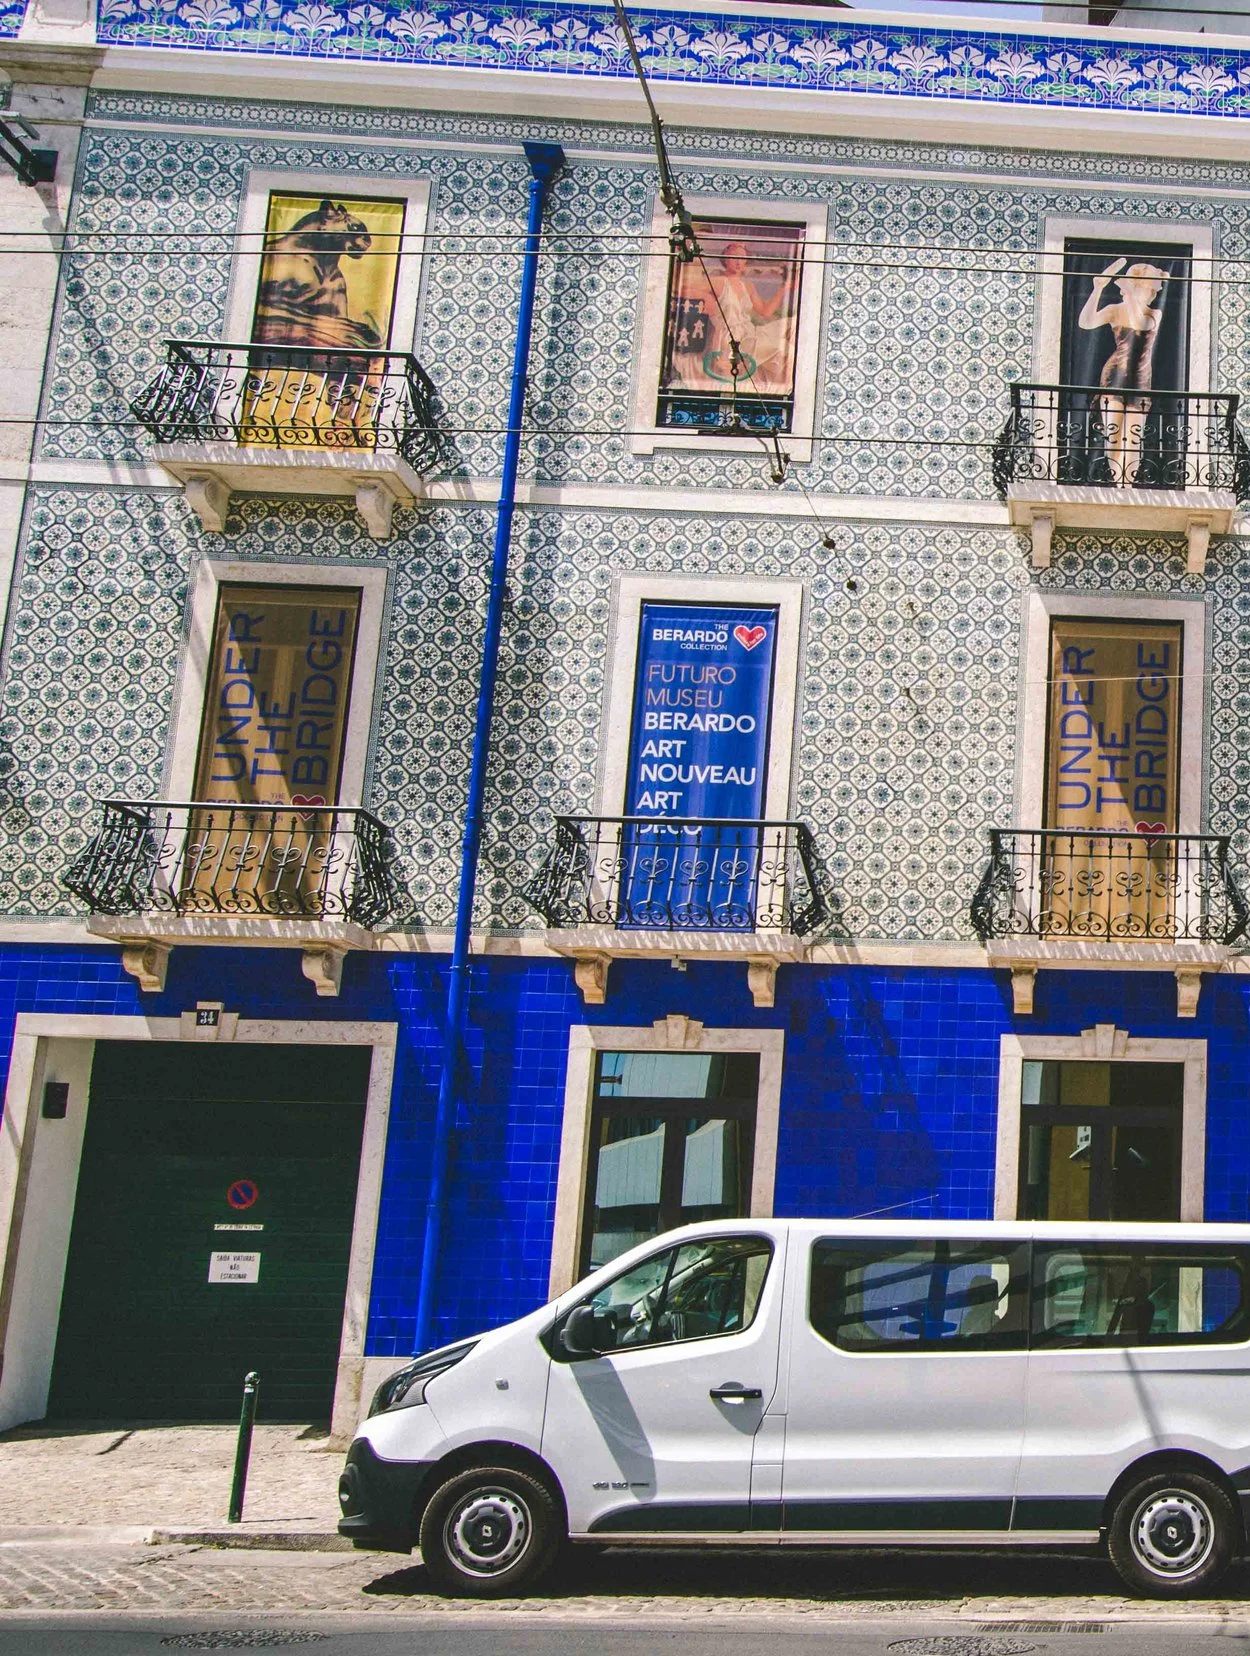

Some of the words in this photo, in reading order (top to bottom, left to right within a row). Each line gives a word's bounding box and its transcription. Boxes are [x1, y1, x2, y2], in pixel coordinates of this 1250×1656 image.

[653, 629, 729, 643] BERARDO
[714, 623, 729, 631] THE
[680, 643, 728, 651] COLLECTION
[648, 664, 737, 685] FUTURO
[211, 611, 265, 782] UNDER
[291, 609, 348, 785] BRIDGE
[646, 688, 723, 708] MUSEU
[644, 712, 756, 733] BERARDO
[1058, 645, 1095, 809] UNDER
[1134, 641, 1170, 813] BRIDGE
[251, 691, 297, 785] THE
[641, 740, 687, 758] ART
[640, 763, 756, 785] NOUVEAU
[1096, 721, 1131, 813] THE
[637, 791, 683, 810] ART
[200, 1011, 214, 1024] 34
